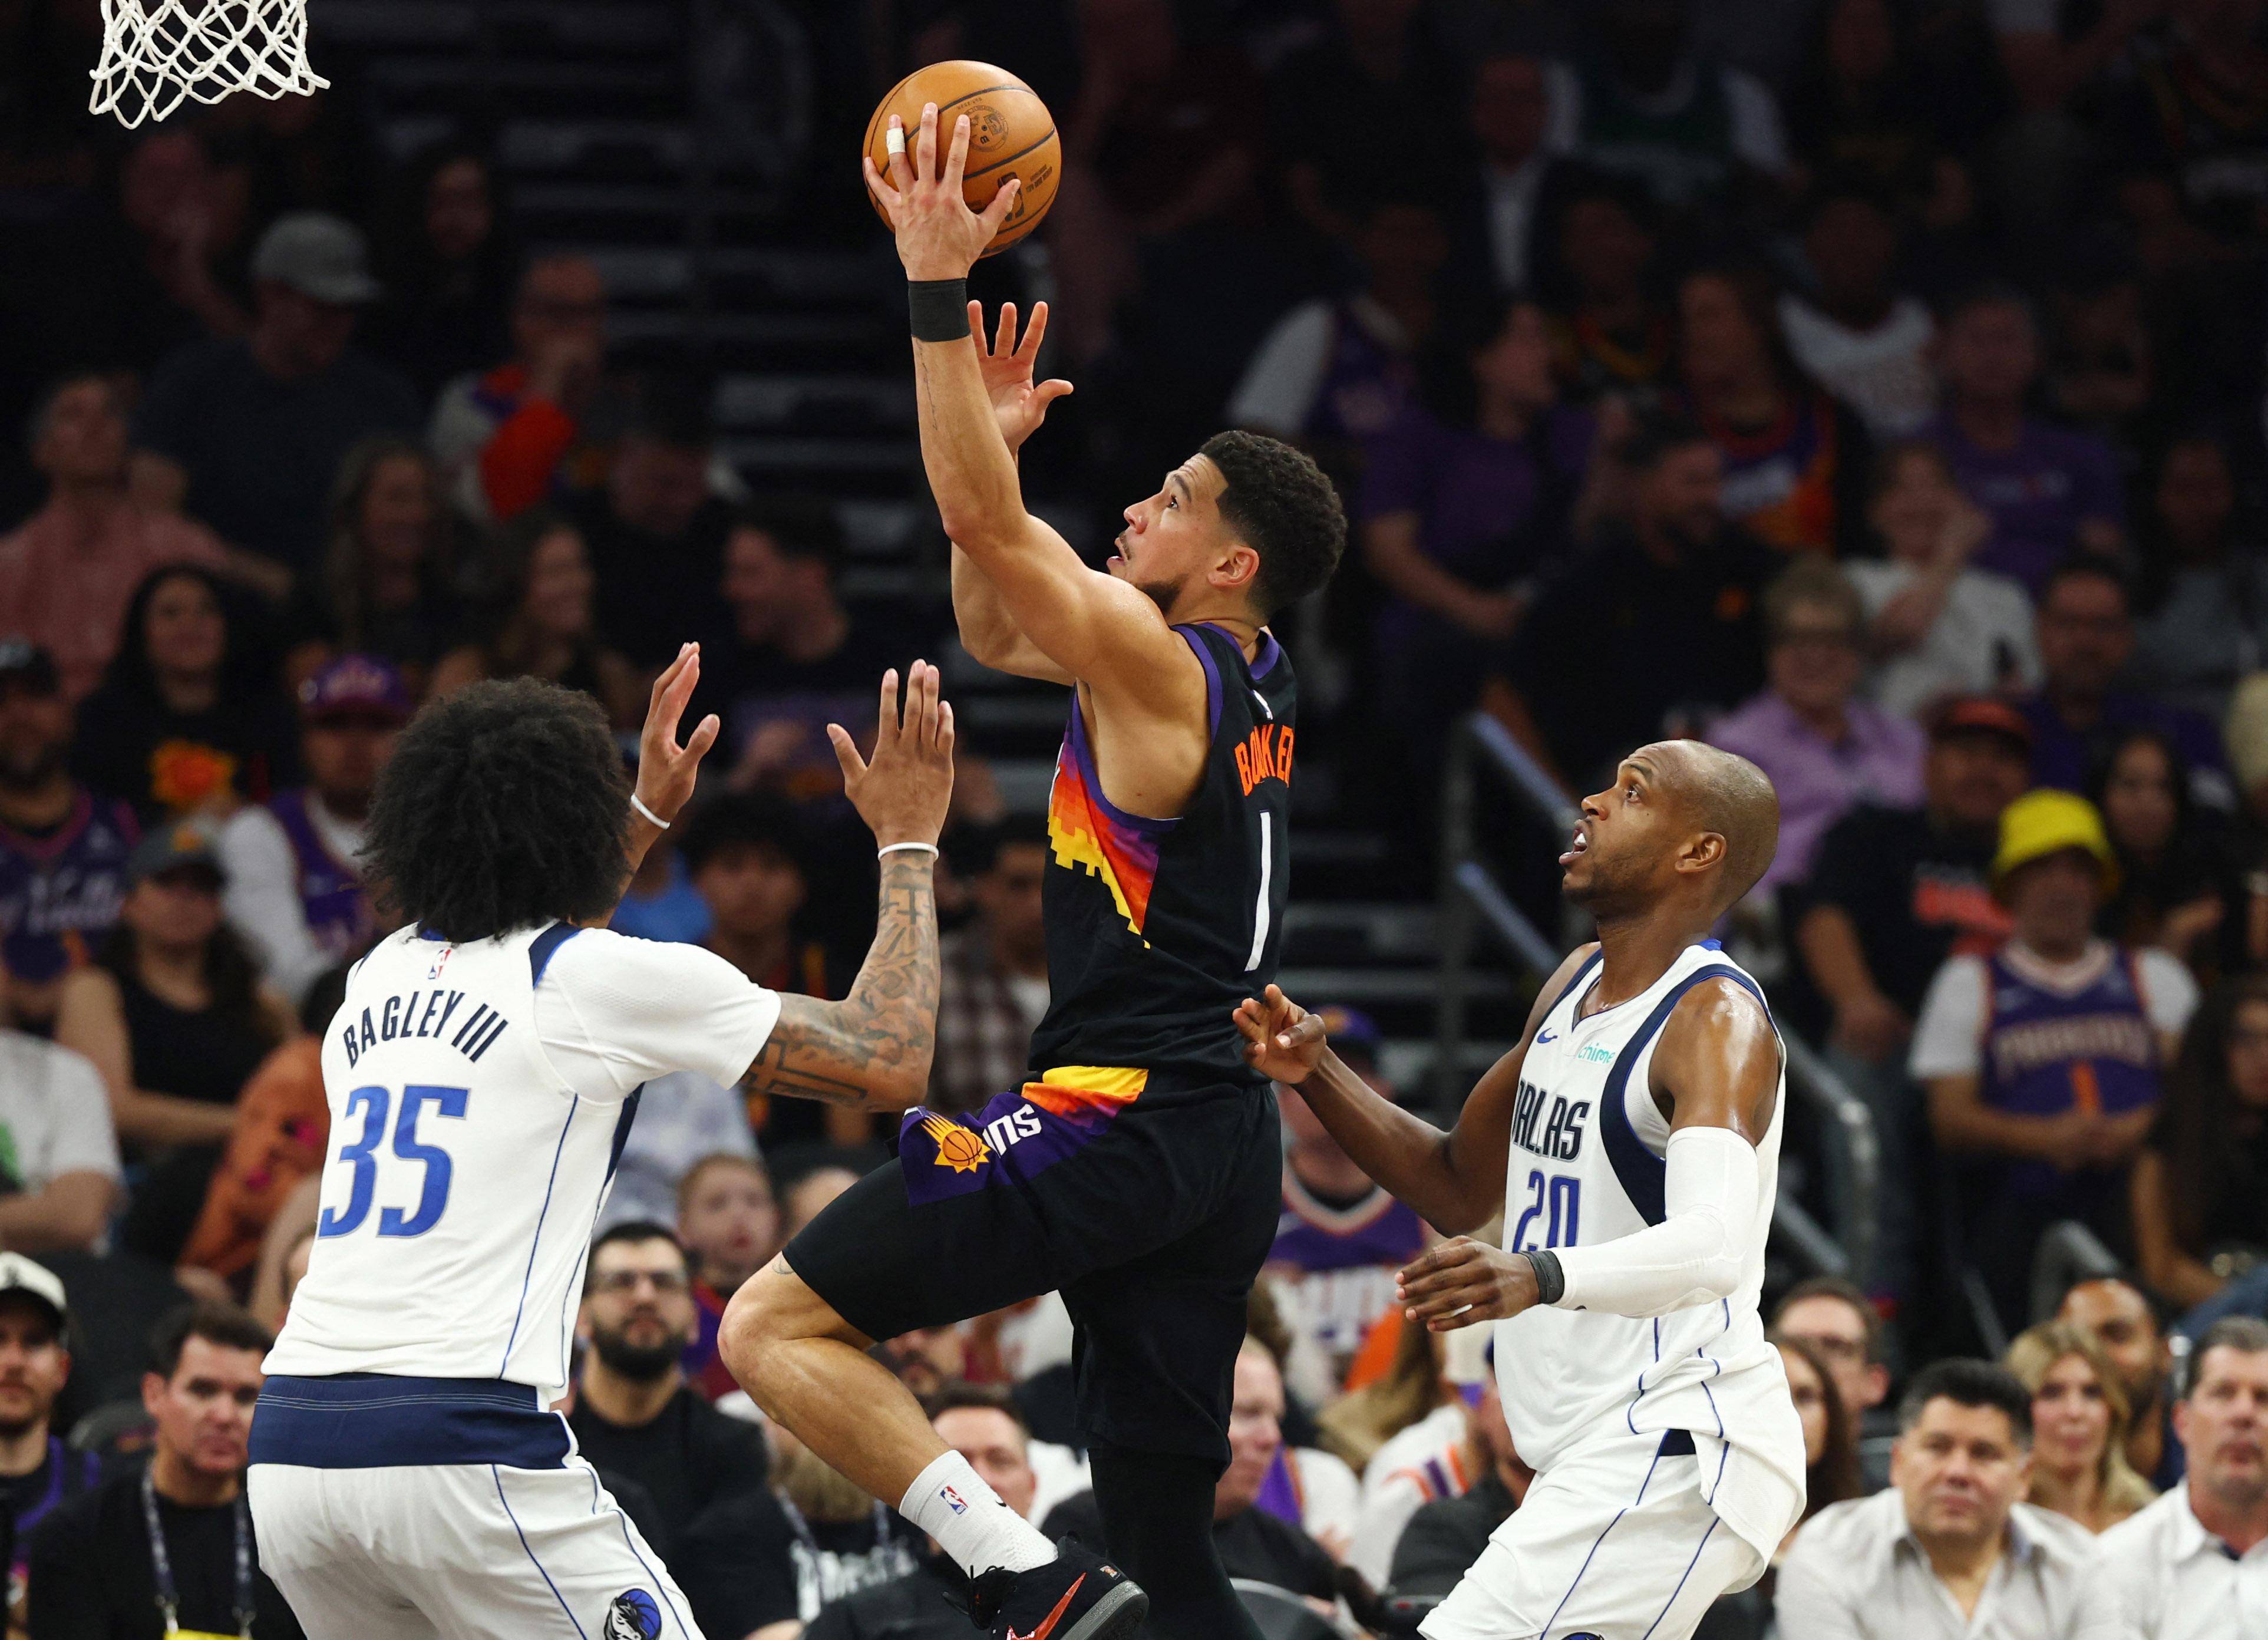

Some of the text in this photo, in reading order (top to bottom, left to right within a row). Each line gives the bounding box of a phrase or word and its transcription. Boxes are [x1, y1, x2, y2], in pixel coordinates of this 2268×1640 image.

[1244, 810, 1272, 972] 1
[343, 990, 509, 1070] BAGLEY III
[1578, 1042, 1616, 1064] chime
[318, 1083, 471, 1240] 35
[1511, 1079, 1592, 1162] ALAS
[1512, 1169, 1582, 1254] 20
